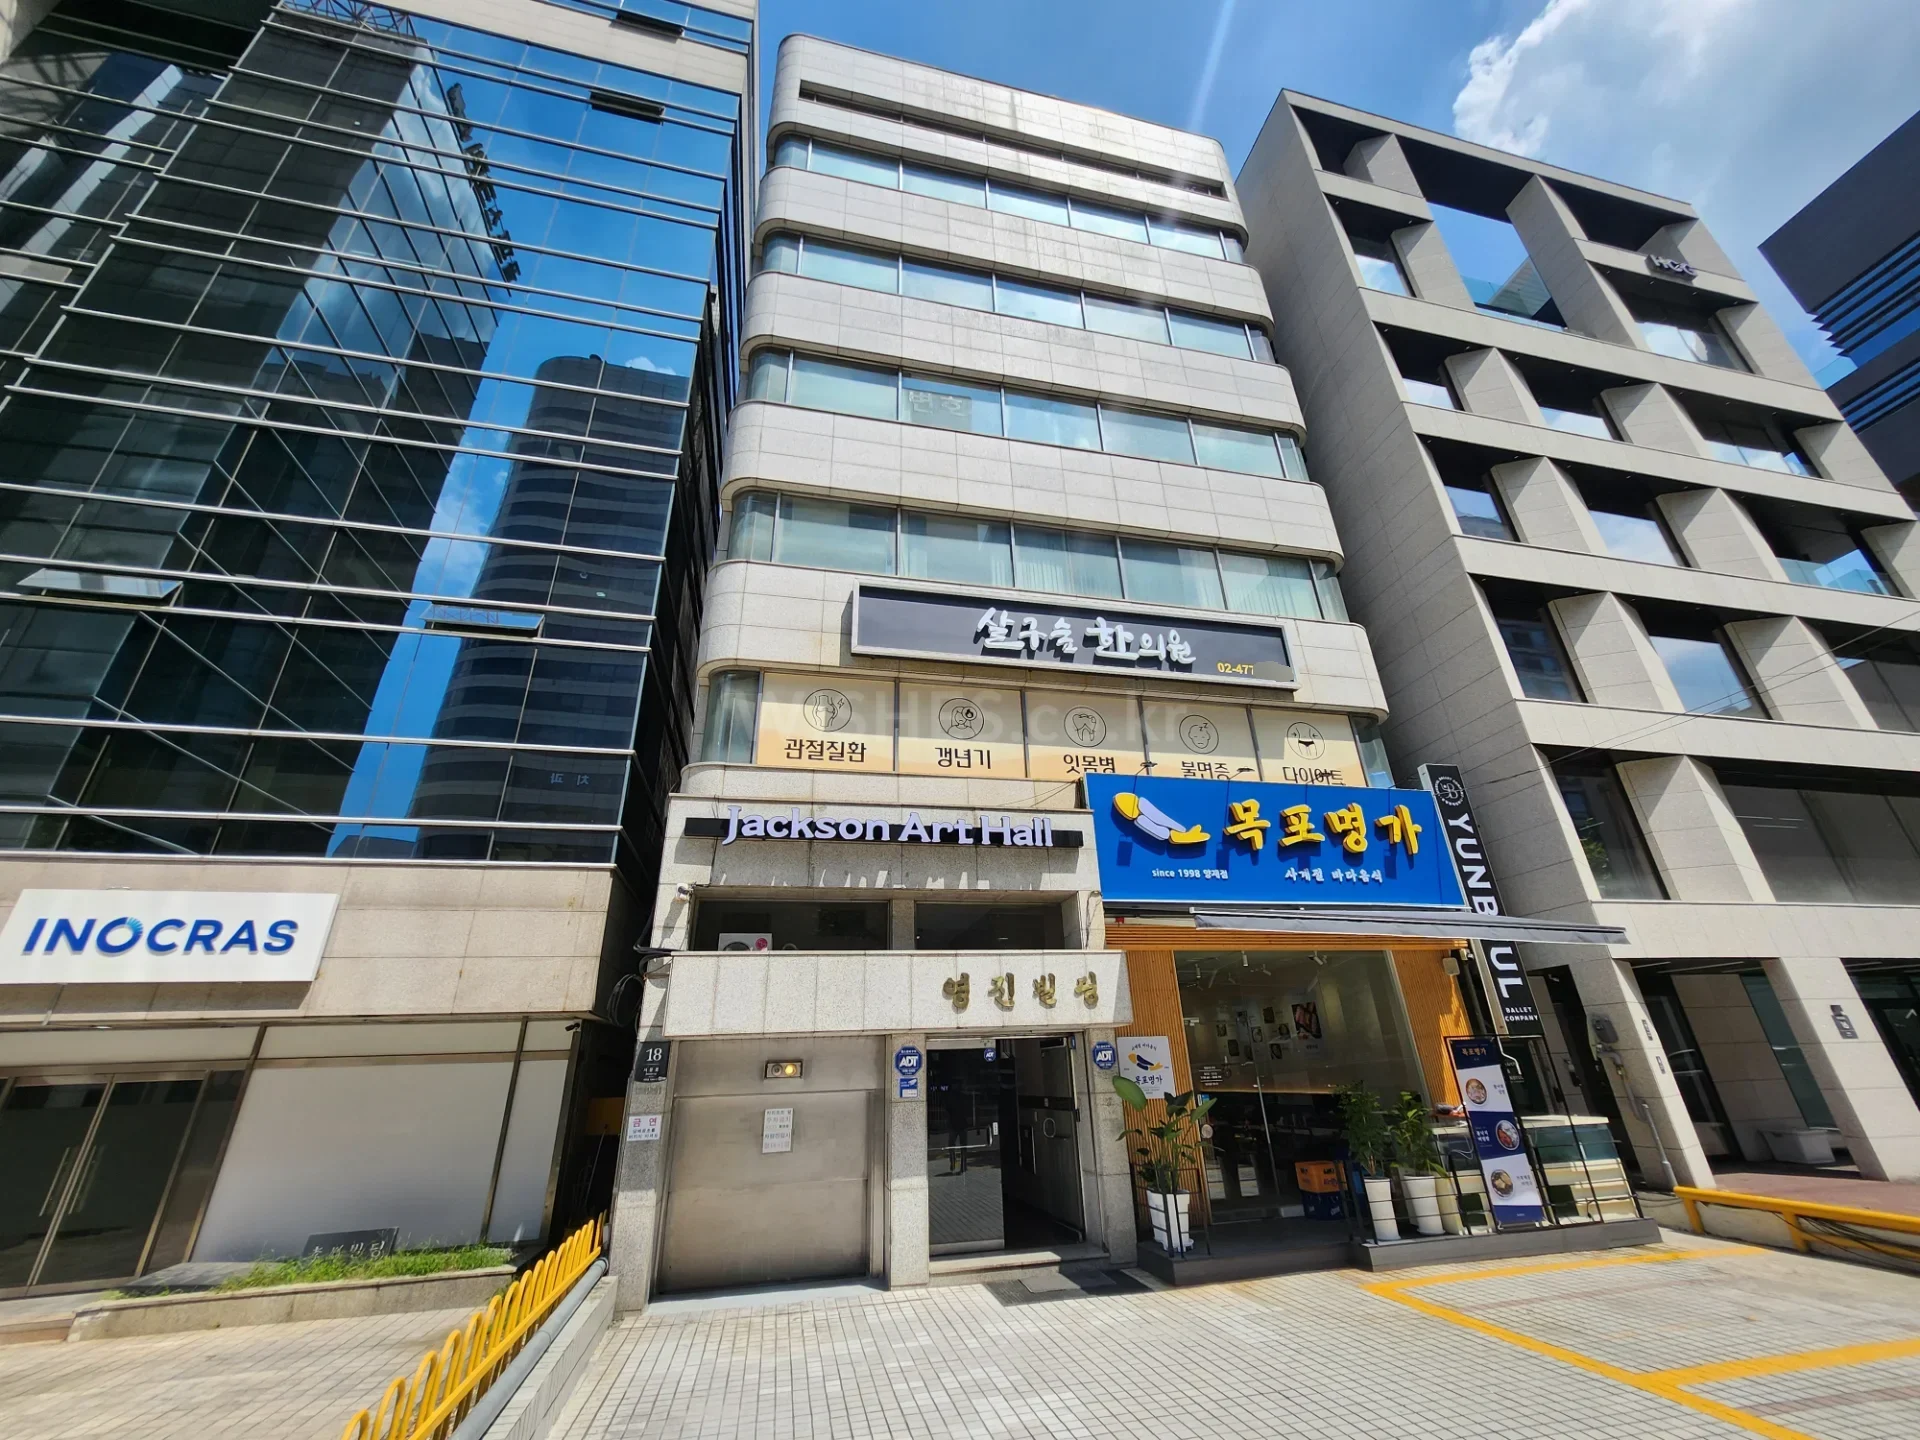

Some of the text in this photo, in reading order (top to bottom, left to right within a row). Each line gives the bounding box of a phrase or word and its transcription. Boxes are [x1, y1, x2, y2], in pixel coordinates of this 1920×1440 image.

[1085, 616, 1197, 664] 한의원
[784, 738, 867, 763] 관절질환
[934, 746, 992, 770] 갱년기
[1063, 754, 1116, 774] 잇몸병
[1181, 760, 1230, 780] 불면증
[1282, 766, 1345, 786] 다이어트
[721, 804, 1054, 847] Jackson Art Hall
[1223, 799, 1423, 855] 목포명가
[1152, 868, 1229, 879] since 1998 양재점
[1284, 866, 1383, 883] 사계절 바다음식
[1447, 812, 1524, 999] YUNBUL
[21, 916, 299, 954] INOCRAS
[943, 971, 1099, 1011] 영진빌딩
[1504, 1013, 1539, 1022] COMPANY
[1505, 1006, 1533, 1014] BALLET
[645, 1047, 662, 1062] 18
[899, 1055, 919, 1068] ADT
[1096, 1050, 1113, 1062] ADT
